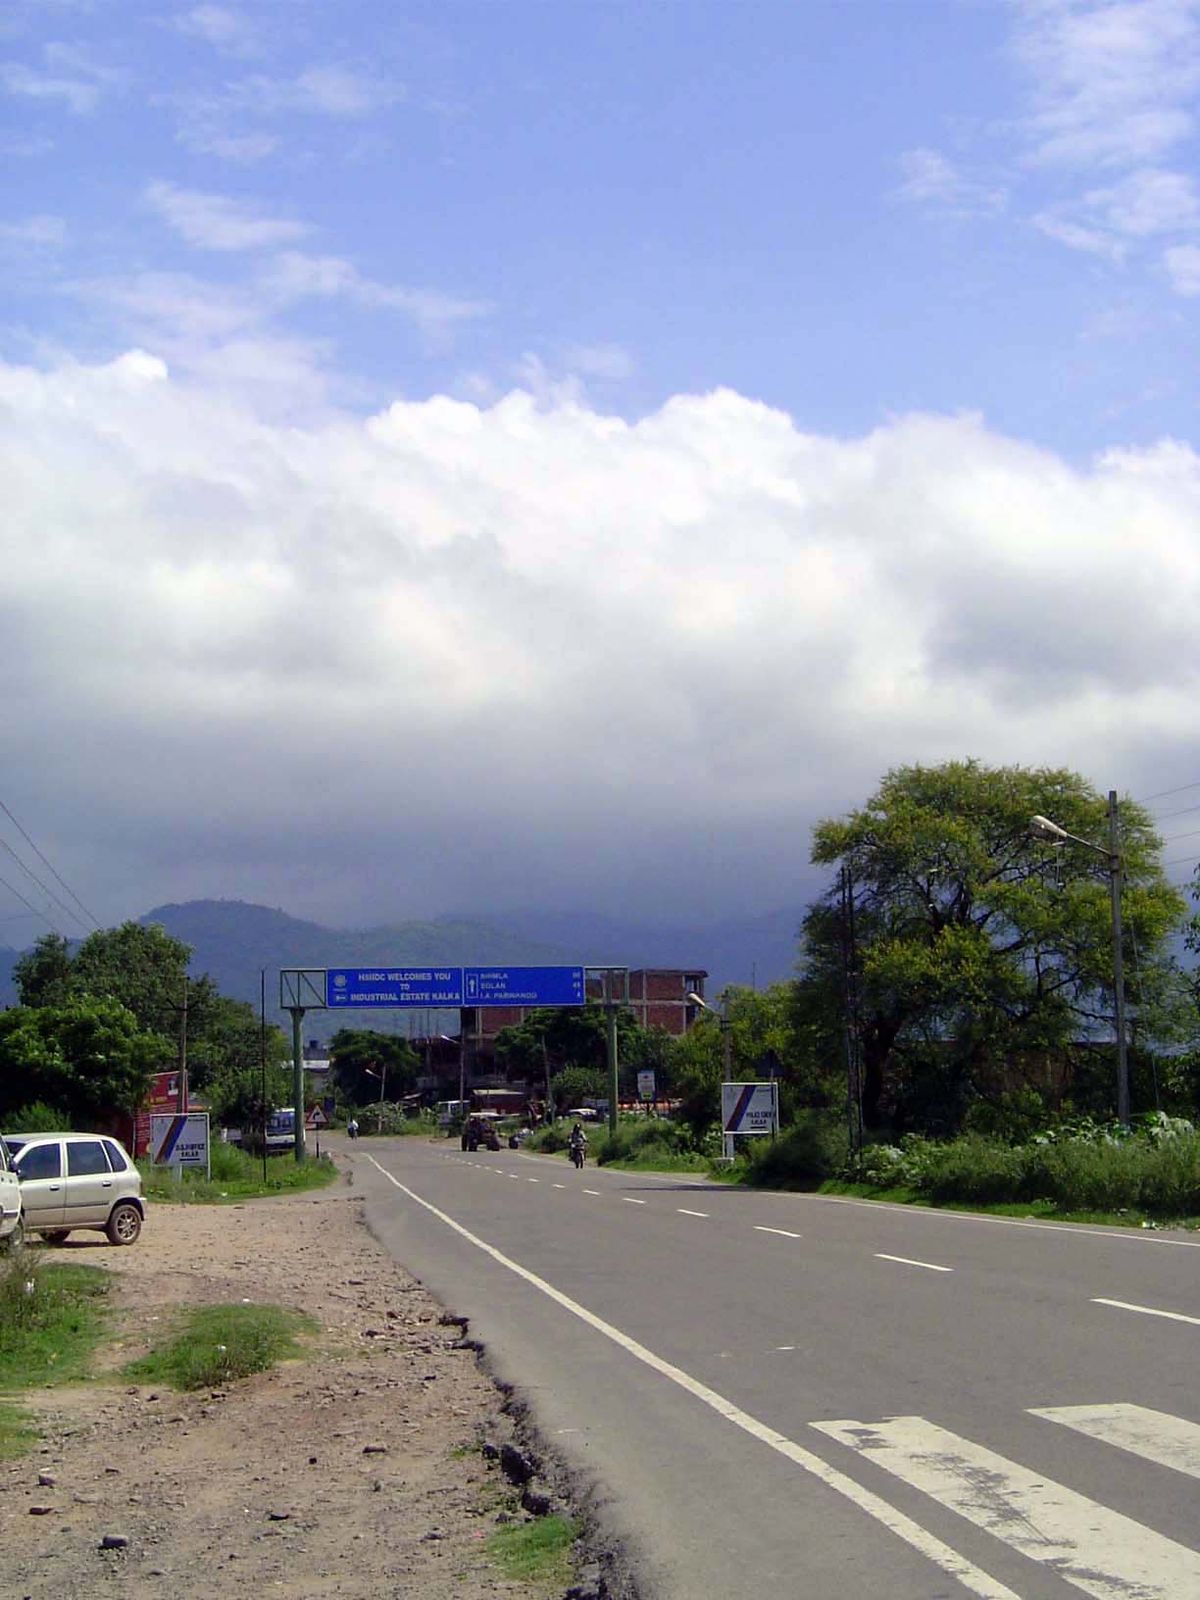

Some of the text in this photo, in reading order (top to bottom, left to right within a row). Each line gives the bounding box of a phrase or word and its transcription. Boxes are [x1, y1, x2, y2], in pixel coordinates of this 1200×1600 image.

[387, 973, 433, 981] WELCOMES
[434, 972, 451, 981] YOU
[399, 983, 410, 991] TO
[351, 993, 399, 1002] INDUSTRIAL
[400, 993, 430, 1001] ESTATE
